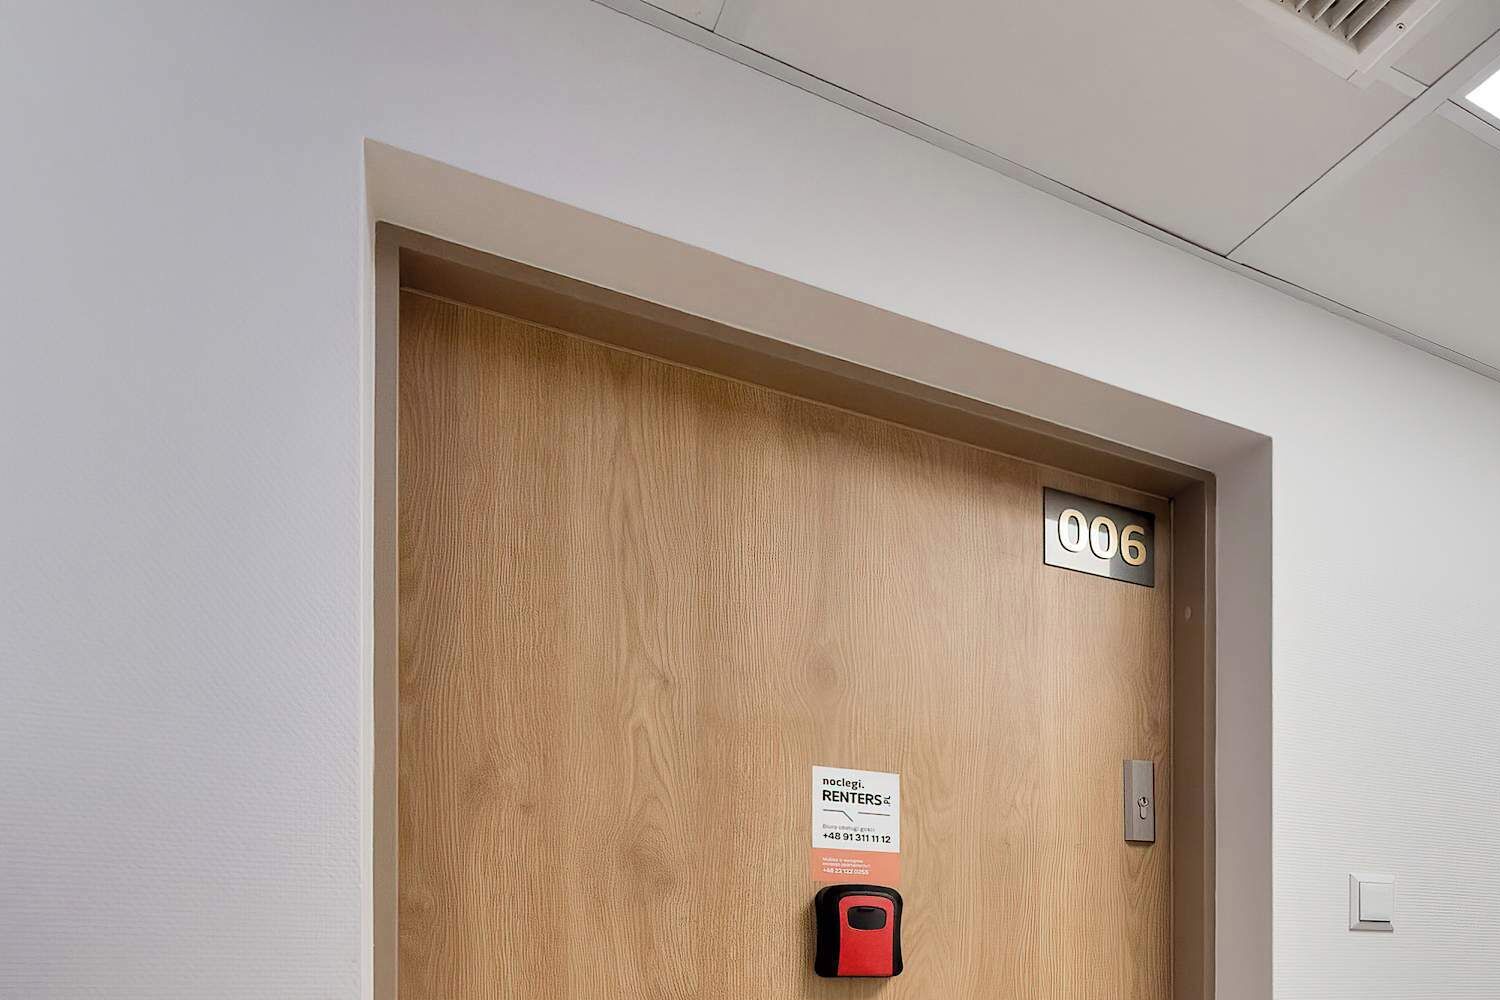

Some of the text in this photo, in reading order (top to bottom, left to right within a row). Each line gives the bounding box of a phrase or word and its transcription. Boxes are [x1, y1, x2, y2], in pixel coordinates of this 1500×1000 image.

[1058, 508, 1147, 567] 006
[822, 778, 865, 790] noclegi.
[822, 789, 882, 806] RENTERS
[823, 832, 891, 844] +48 91 311 11 12
